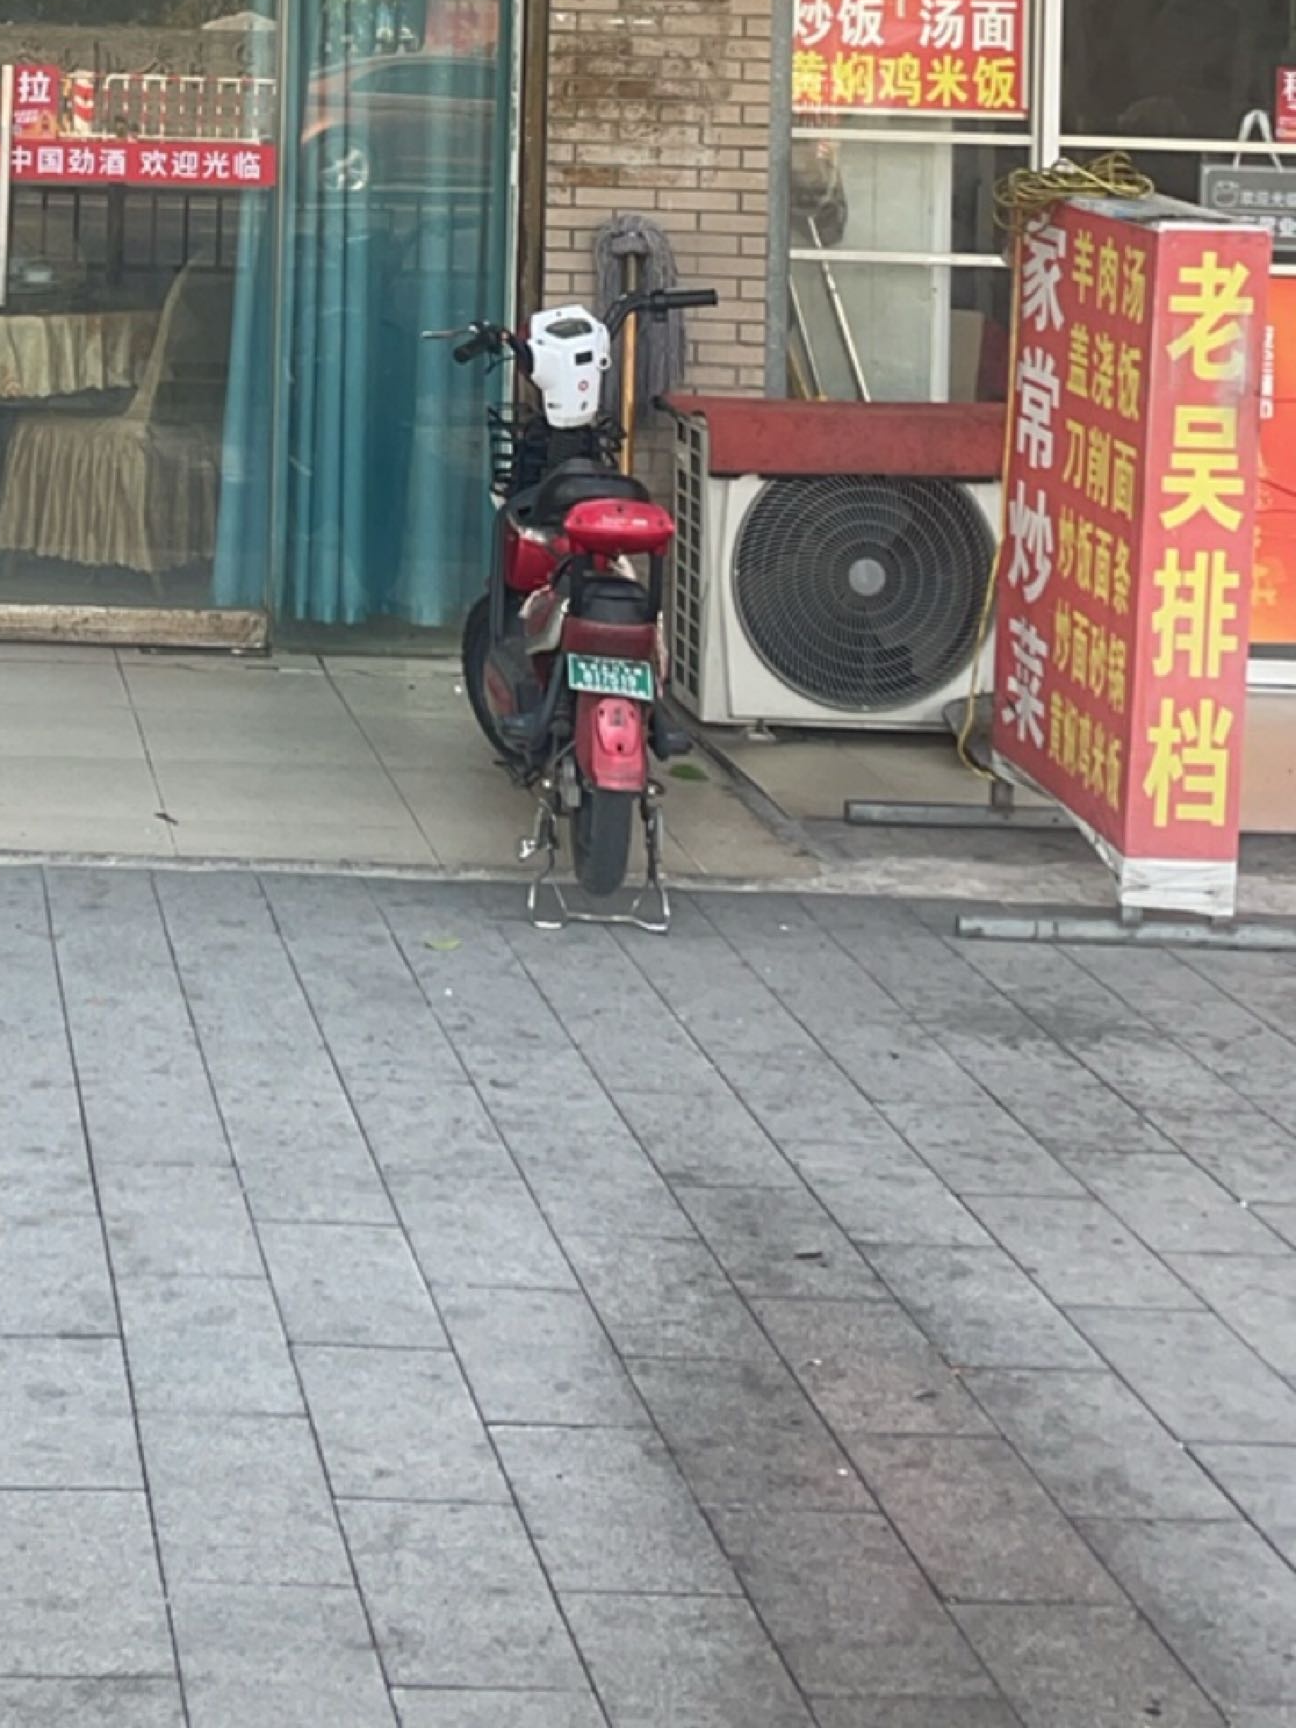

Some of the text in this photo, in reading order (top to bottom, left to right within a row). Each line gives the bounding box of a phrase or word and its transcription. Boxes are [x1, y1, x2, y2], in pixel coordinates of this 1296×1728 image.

[19, 71, 51, 104] 拉
[792, 50, 1016, 108] 黄焖鸡米饭
[10, 144, 261, 180] 中国劲酒 欢迎光临
[1071, 228, 1146, 325] 羊肉汤
[1065, 322, 1142, 421] 盖浇饭
[1002, 214, 1067, 749] 家常炒菜
[1061, 418, 1137, 520] 刀削面
[1143, 251, 1255, 829] 老吴排档
